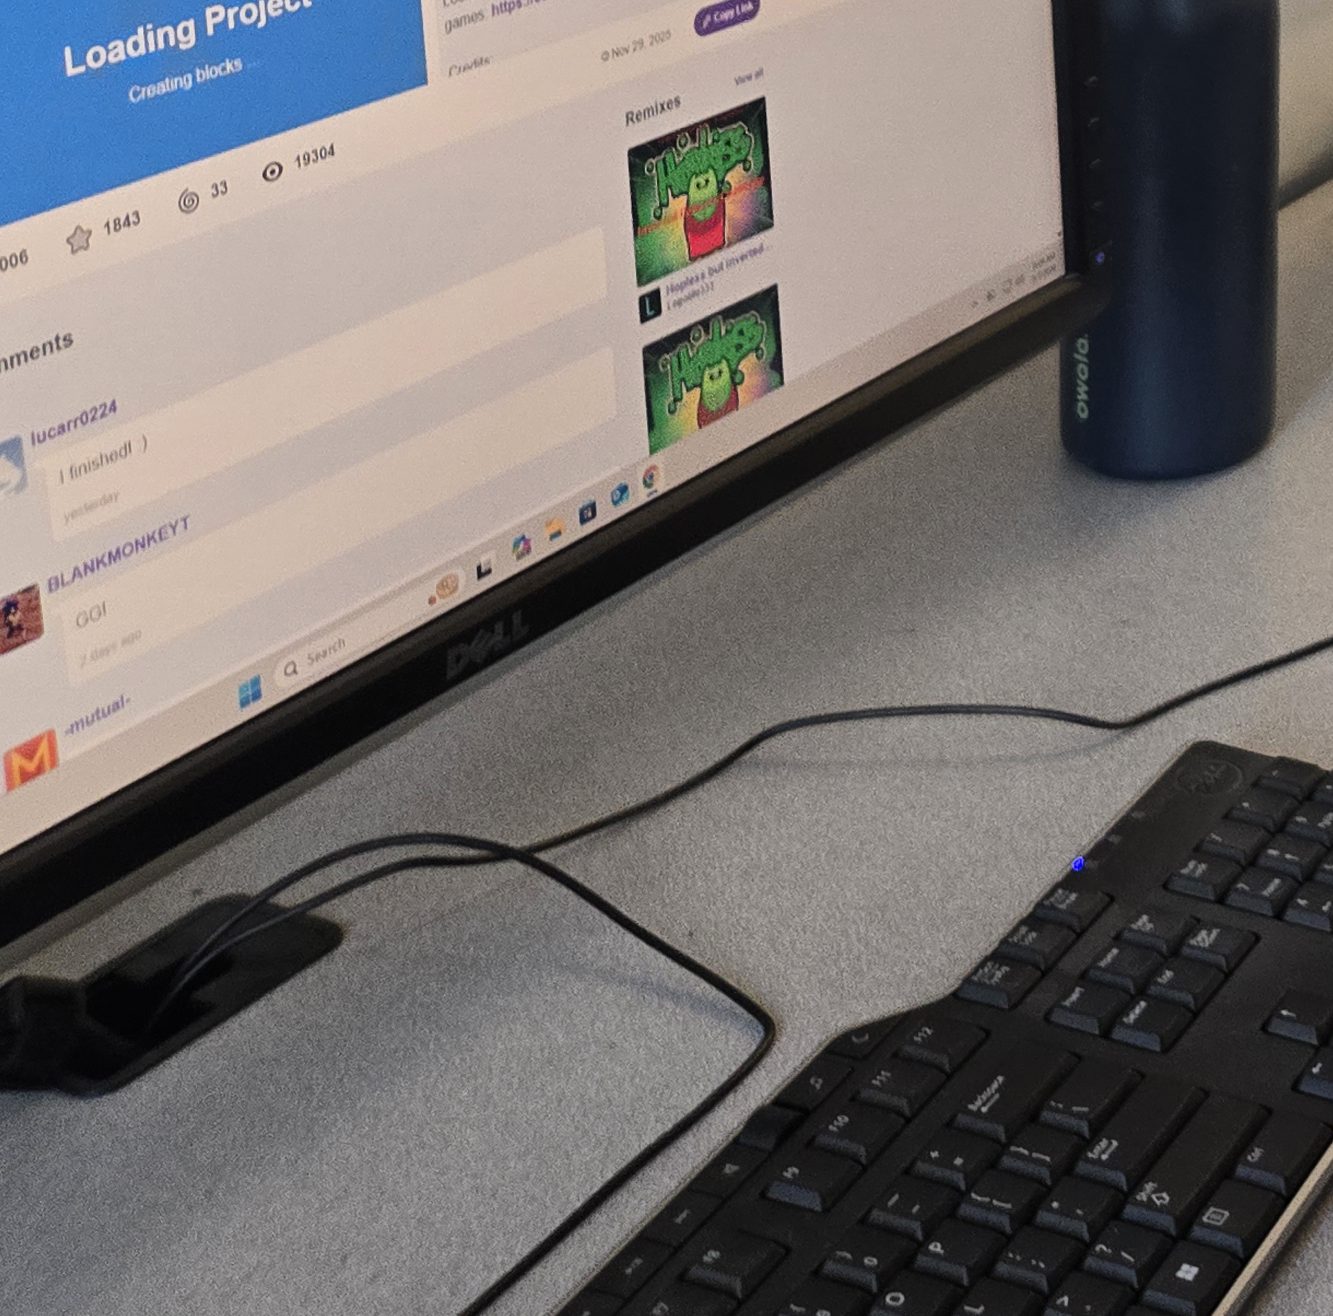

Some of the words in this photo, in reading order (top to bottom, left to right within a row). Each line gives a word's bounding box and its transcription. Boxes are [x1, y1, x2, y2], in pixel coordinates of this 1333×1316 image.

[64, 16, 197, 77] Loading
[128, 72, 193, 104] Creating
[196, 57, 243, 84] blocks
[625, 95, 682, 126] Remixes
[103, 210, 141, 236] 1843
[210, 180, 229, 199] 33
[294, 143, 336, 170] 19304
[1073, 337, 1090, 420] owala
[47, 514, 190, 594] BLANKMONKEYT
